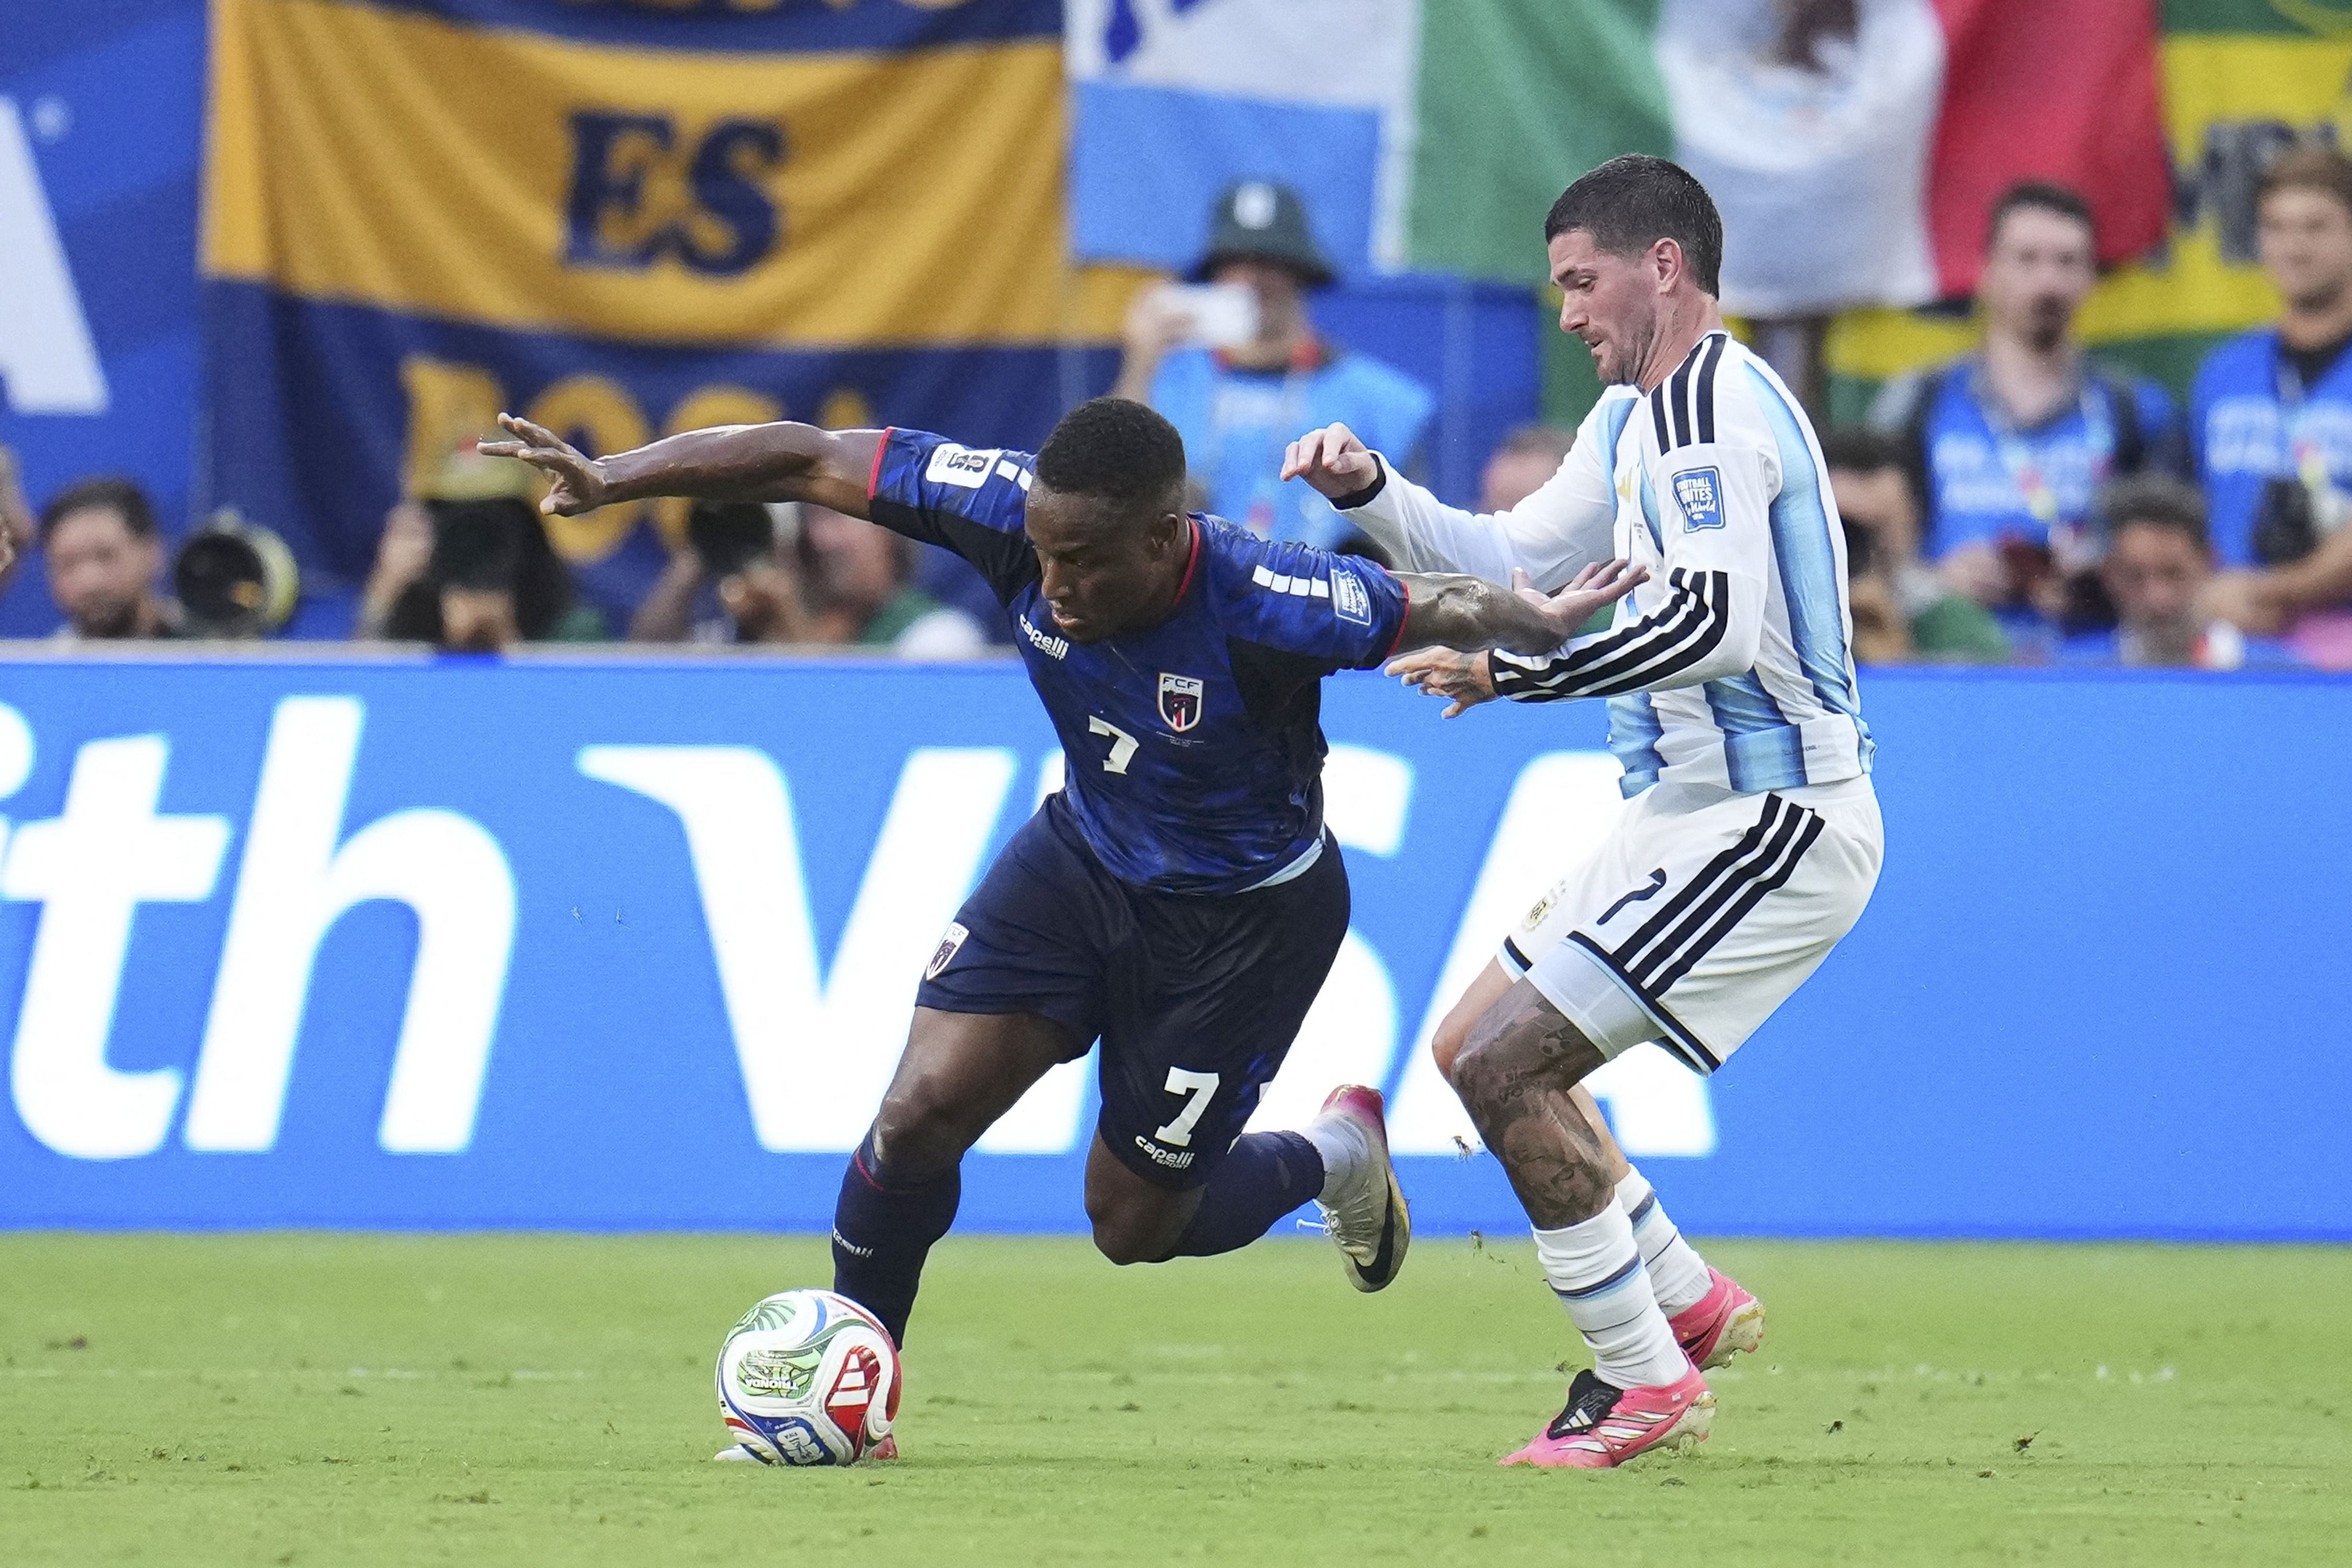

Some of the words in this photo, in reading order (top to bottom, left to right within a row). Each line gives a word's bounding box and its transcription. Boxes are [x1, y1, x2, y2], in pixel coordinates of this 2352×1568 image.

[563, 111, 787, 283] ES
[1020, 614, 1069, 657] capelli
[1163, 677, 1199, 689] FCF
[1089, 715, 1140, 775] 7
[0, 694, 519, 1161] th
[575, 742, 1719, 1157] VSA
[1154, 1066, 1220, 1147] 7
[1135, 1135, 1195, 1166] capelli
[745, 1377, 800, 1390] TRIONDA
